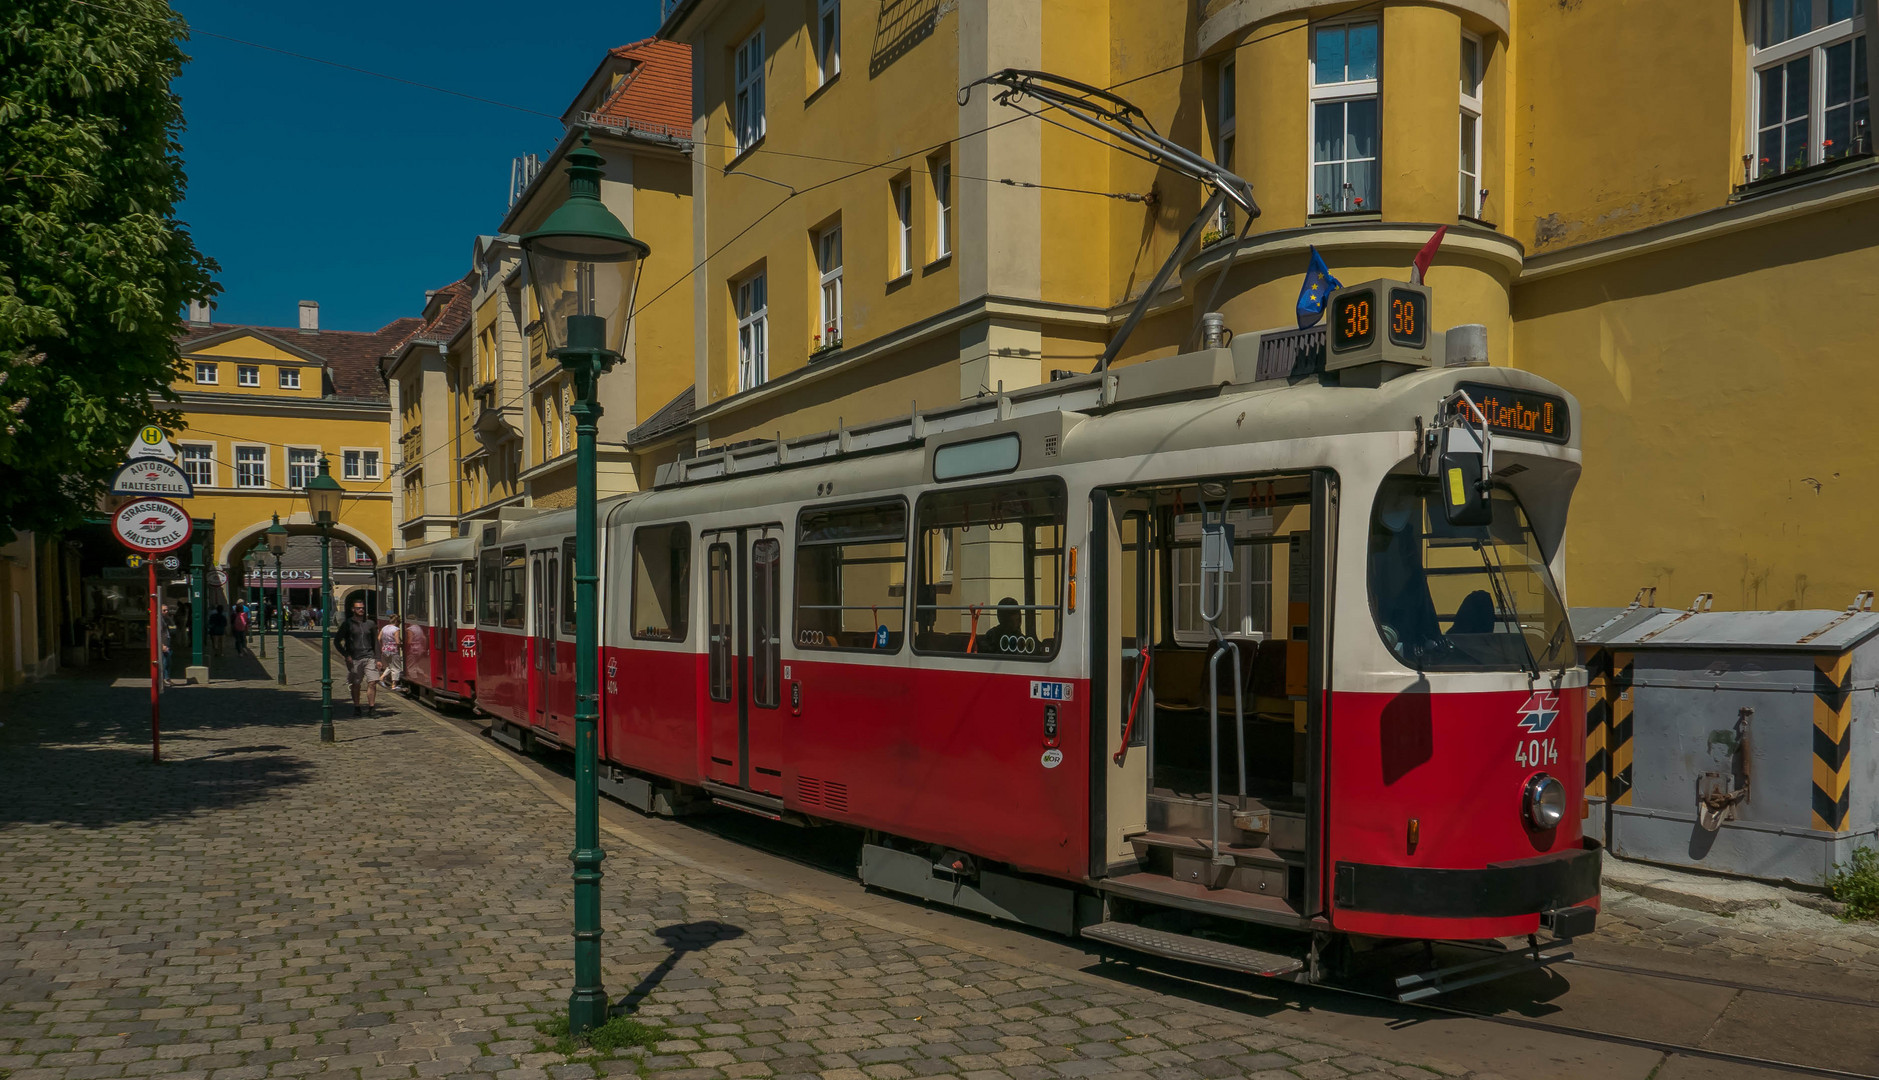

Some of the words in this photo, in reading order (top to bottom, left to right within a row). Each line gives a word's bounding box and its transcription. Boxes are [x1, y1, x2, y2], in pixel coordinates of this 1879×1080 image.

[1344, 301, 1369, 338] 38
[1393, 299, 1414, 335] 38
[146, 430, 158, 442] H
[130, 463, 176, 478] AUTOBUS
[121, 481, 184, 493] HALTESTELLE
[121, 503, 184, 523] STRASSENBAHN
[124, 529, 182, 546] HALTESTELLE
[1514, 737, 1558, 768] 4014
